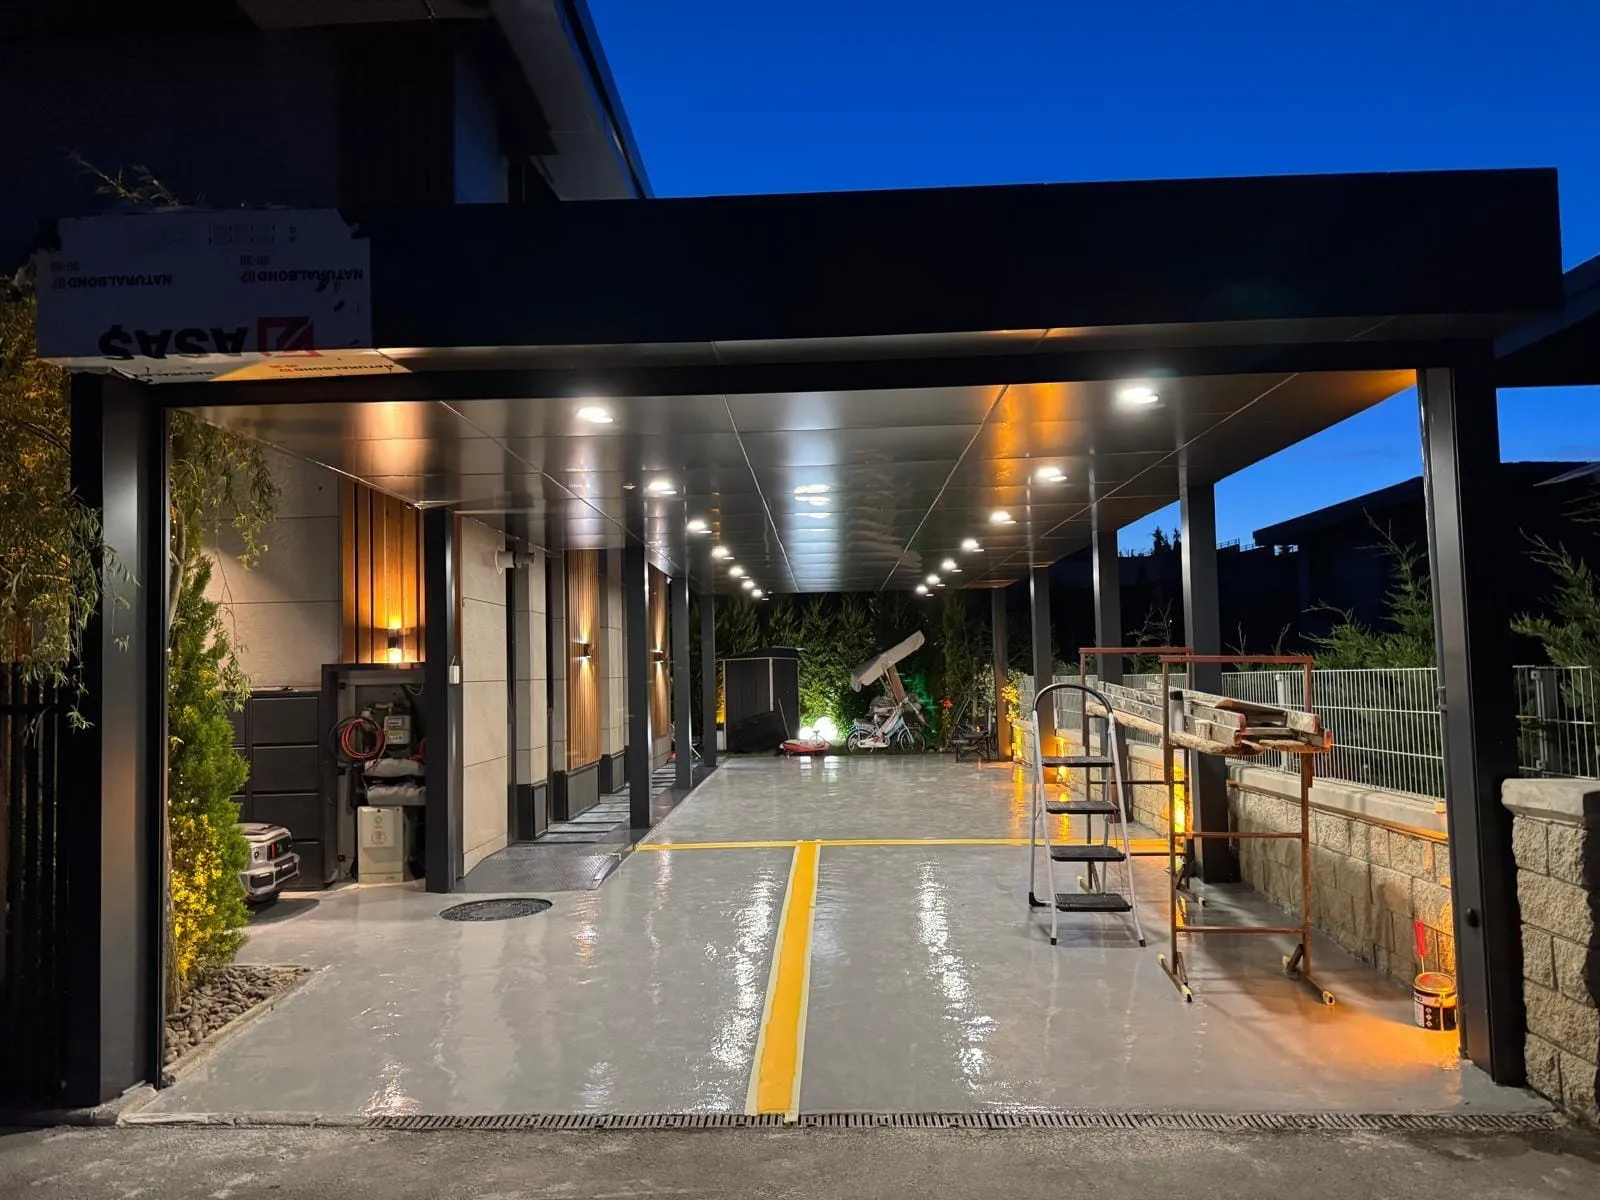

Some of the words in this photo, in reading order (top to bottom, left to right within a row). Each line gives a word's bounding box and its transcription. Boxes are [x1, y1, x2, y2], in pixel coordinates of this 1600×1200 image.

[67, 274, 173, 289] NATURALBOND
[257, 268, 364, 283] NATURALBOND
[98, 325, 249, 359] ASAŞ
